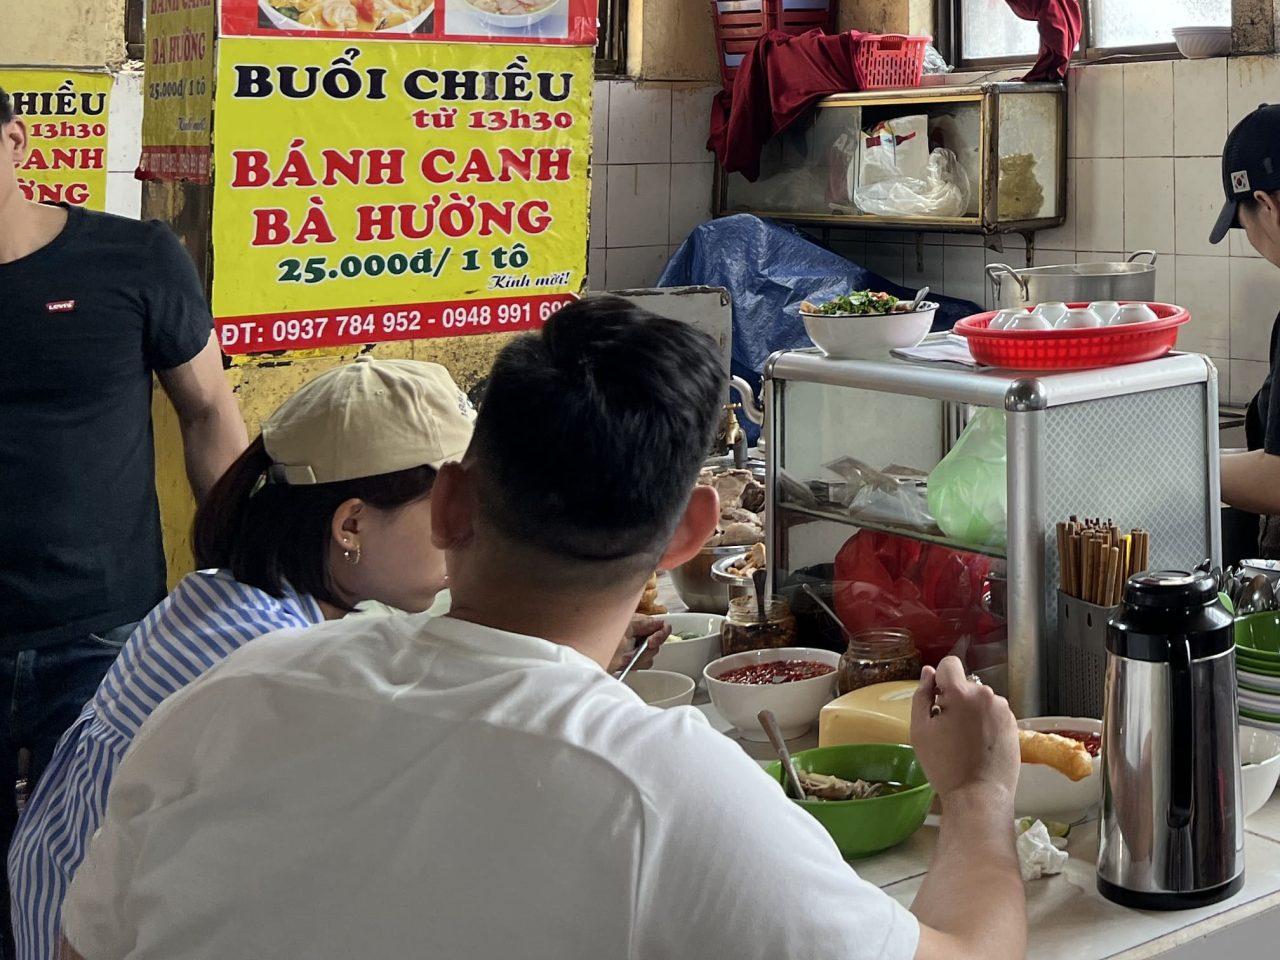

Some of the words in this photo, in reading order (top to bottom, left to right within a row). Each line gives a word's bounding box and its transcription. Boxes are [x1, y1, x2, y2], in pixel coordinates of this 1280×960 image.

[234, 48, 387, 100] BUỔI
[403, 55, 574, 102] CHIỀU
[6, 80, 106, 115] HIỀU
[30, 121, 106, 138] 13h30
[412, 107, 457, 129] từ
[469, 108, 573, 131] 13h30
[14, 148, 104, 169] ANH
[231, 138, 406, 188] BÁNH
[420, 148, 572, 183] CANH
[251, 196, 337, 246] BÀ
[355, 192, 552, 242] HƯỜNG
[462, 249, 480, 270] 1
[491, 243, 529, 269] tô
[221, 323, 264, 346] ĐT:
[272, 317, 326, 341] 0937
[335, 314, 376, 337] 784
[383, 310, 421, 332] 952
[442, 305, 491, 328] 0948
[498, 302, 531, 324] 991
